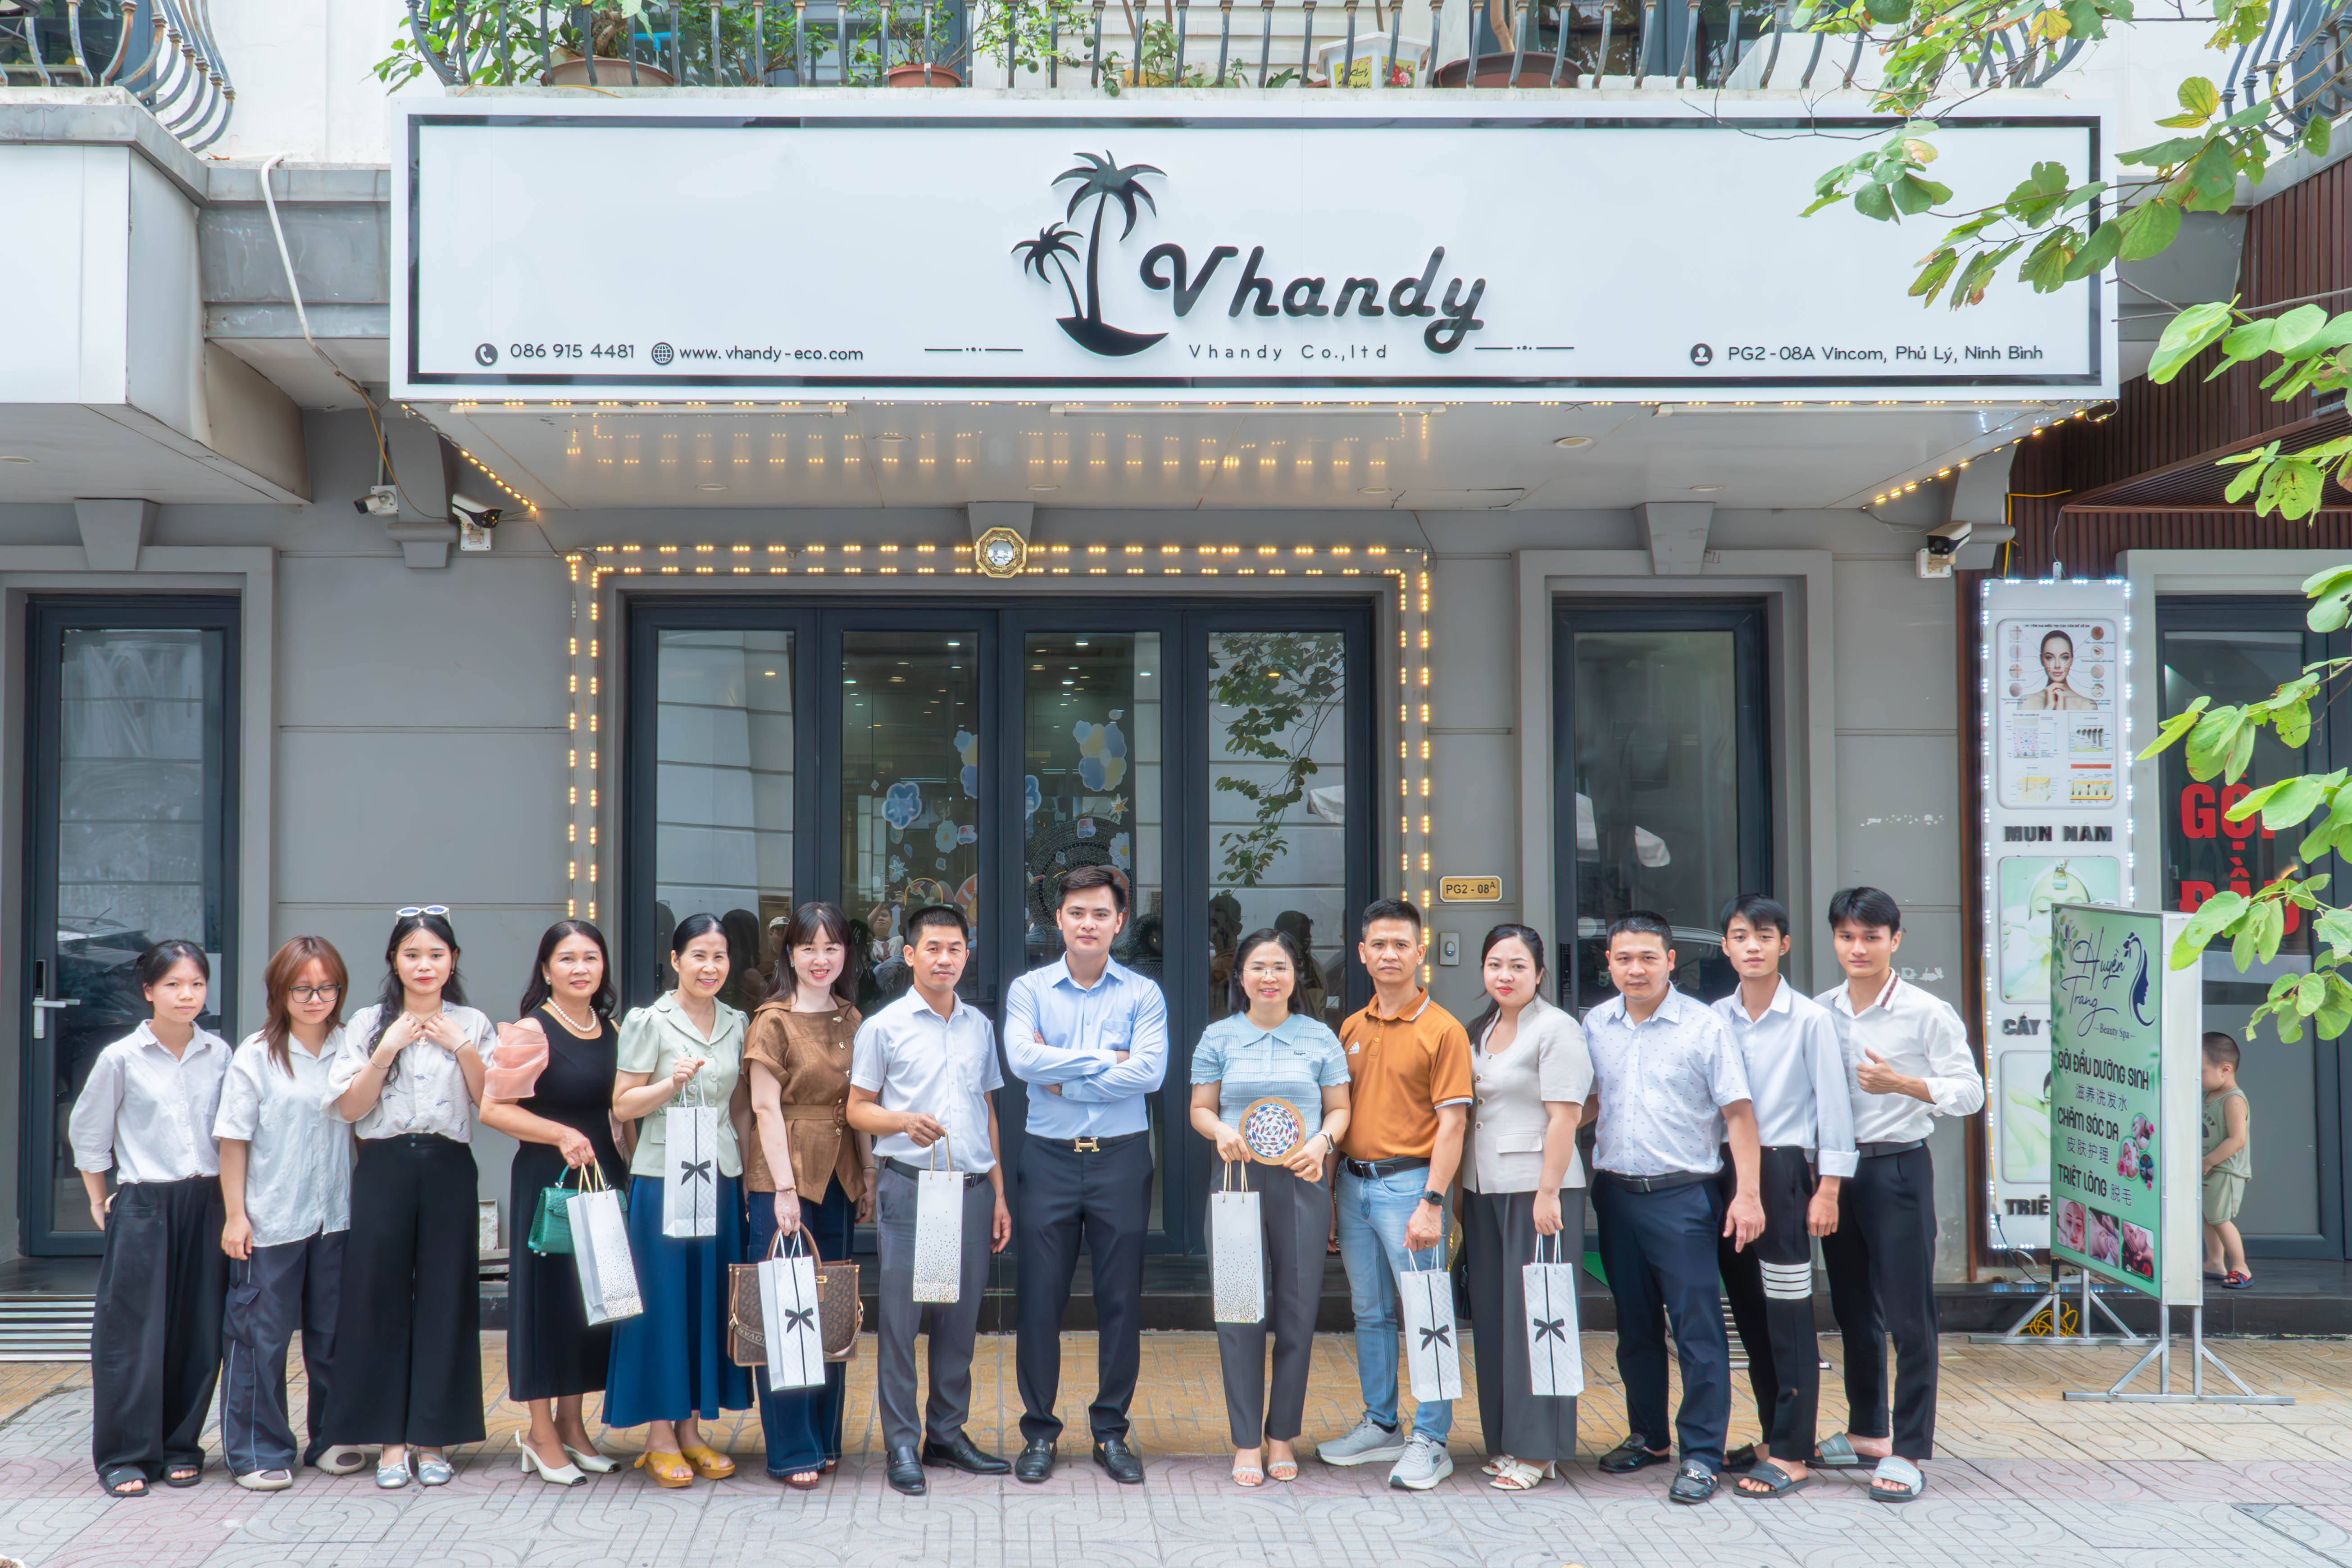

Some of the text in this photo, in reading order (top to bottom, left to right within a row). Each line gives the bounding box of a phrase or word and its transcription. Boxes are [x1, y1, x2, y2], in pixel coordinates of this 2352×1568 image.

[1140, 244, 1485, 354] Vhandy
[510, 343, 634, 358] 086 915 4481
[1189, 344, 1386, 361] Vhandy Co.,ltd
[1822, 346, 1887, 364] Vincom,
[1896, 345, 1926, 360] Phủ
[1934, 346, 1957, 364] Lý,
[1965, 345, 2001, 359] Ninh
[2008, 345, 2043, 359] Bình
[1446, 884, 1468, 894] PG2
[2072, 926, 2125, 991] Huyền
[2060, 975, 2119, 1036] Trang
[2100, 1023, 2130, 1041] Beauty Spa
[2058, 1047, 2071, 1074] GỘI
[2073, 1048, 2091, 1075] ĐẦU
[2075, 1083, 2127, 1112] 滋养洗发水
[2086, 1112, 2104, 1137] SÓC
[2106, 1120, 2119, 1142] DA
[2067, 1136, 2109, 1164] 皮肤护理
[2058, 1164, 2082, 1190] TRIỆT
[2111, 1184, 2132, 1206] 脱毛
